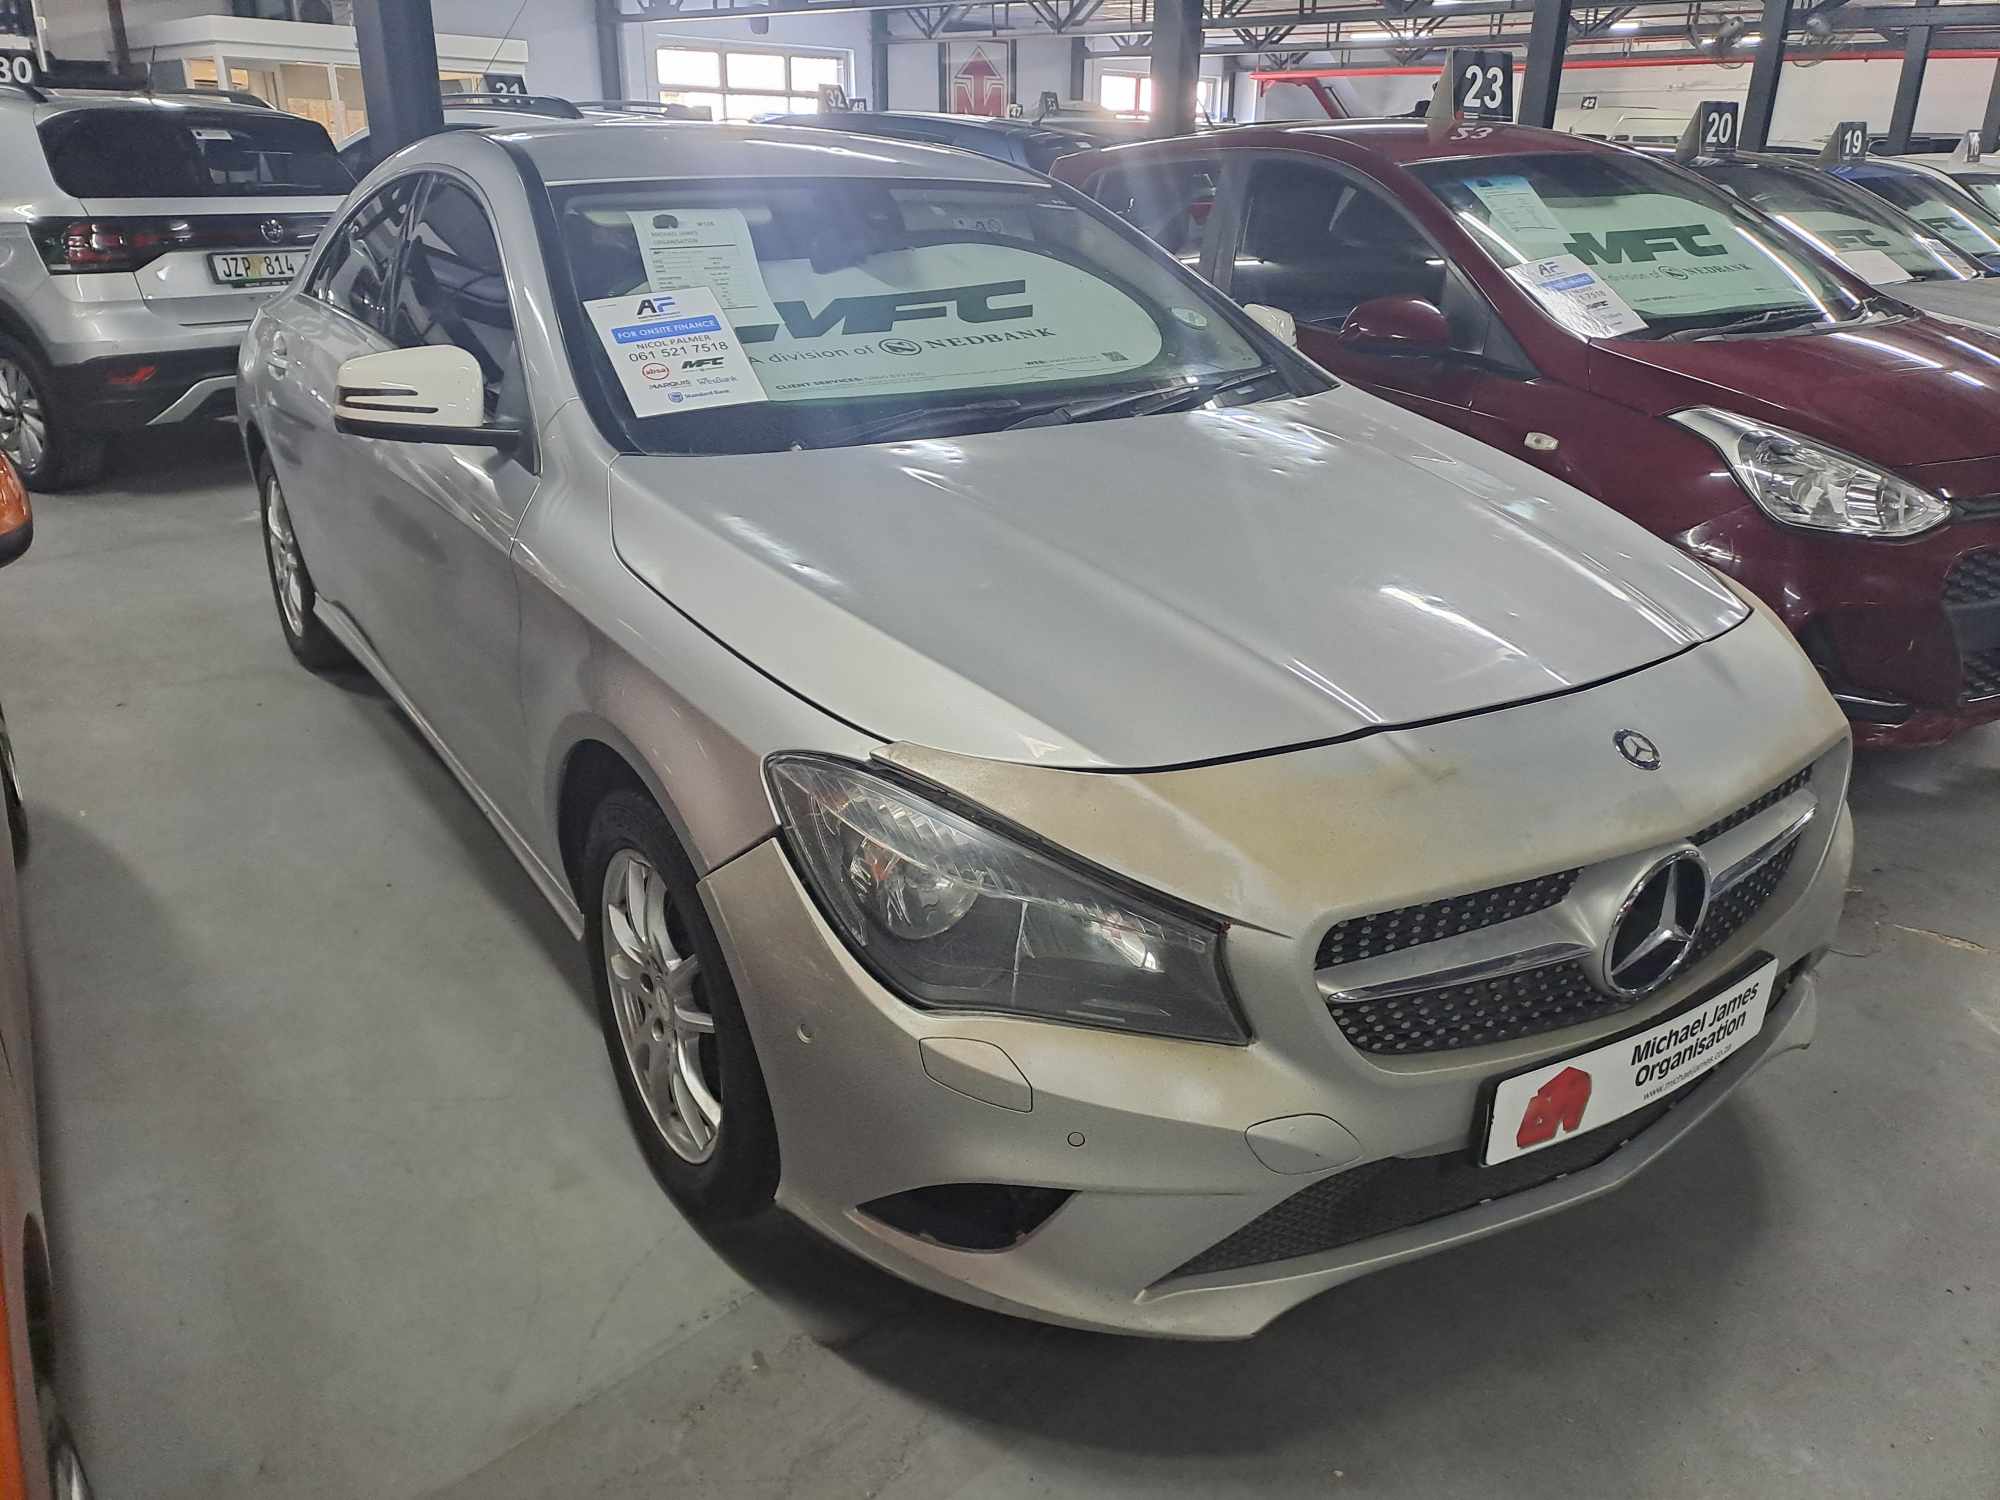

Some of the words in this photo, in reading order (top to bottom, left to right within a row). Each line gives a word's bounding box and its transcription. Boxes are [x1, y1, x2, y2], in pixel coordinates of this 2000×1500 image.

[1463, 64, 1504, 109] 23
[1705, 112, 1733, 144] 20
[1843, 129, 1863, 154] 19
[1562, 223, 1729, 266] MFC
[222, 256, 252, 277] JZP
[264, 255, 295, 275] 814
[636, 296, 676, 316] AF
[617, 330, 637, 340] FOR
[640, 325, 674, 337] ONSITE
[674, 319, 717, 333] FINANCE
[629, 350, 656, 362] 061
[663, 346, 688, 358] 521
[694, 341, 729, 353] 7518
[635, 340, 667, 350] NICOL
[669, 335, 712, 347] PALMER
[750, 355, 766, 366] A
[768, 345, 849, 364] division
[853, 344, 876, 356] of
[922, 327, 1057, 350] NEDBANK
[681, 357, 725, 370] MFC
[1630, 1011, 1708, 1067] Michael
[1708, 981, 1760, 1027] James
[1634, 1010, 1747, 1087] Organisation
